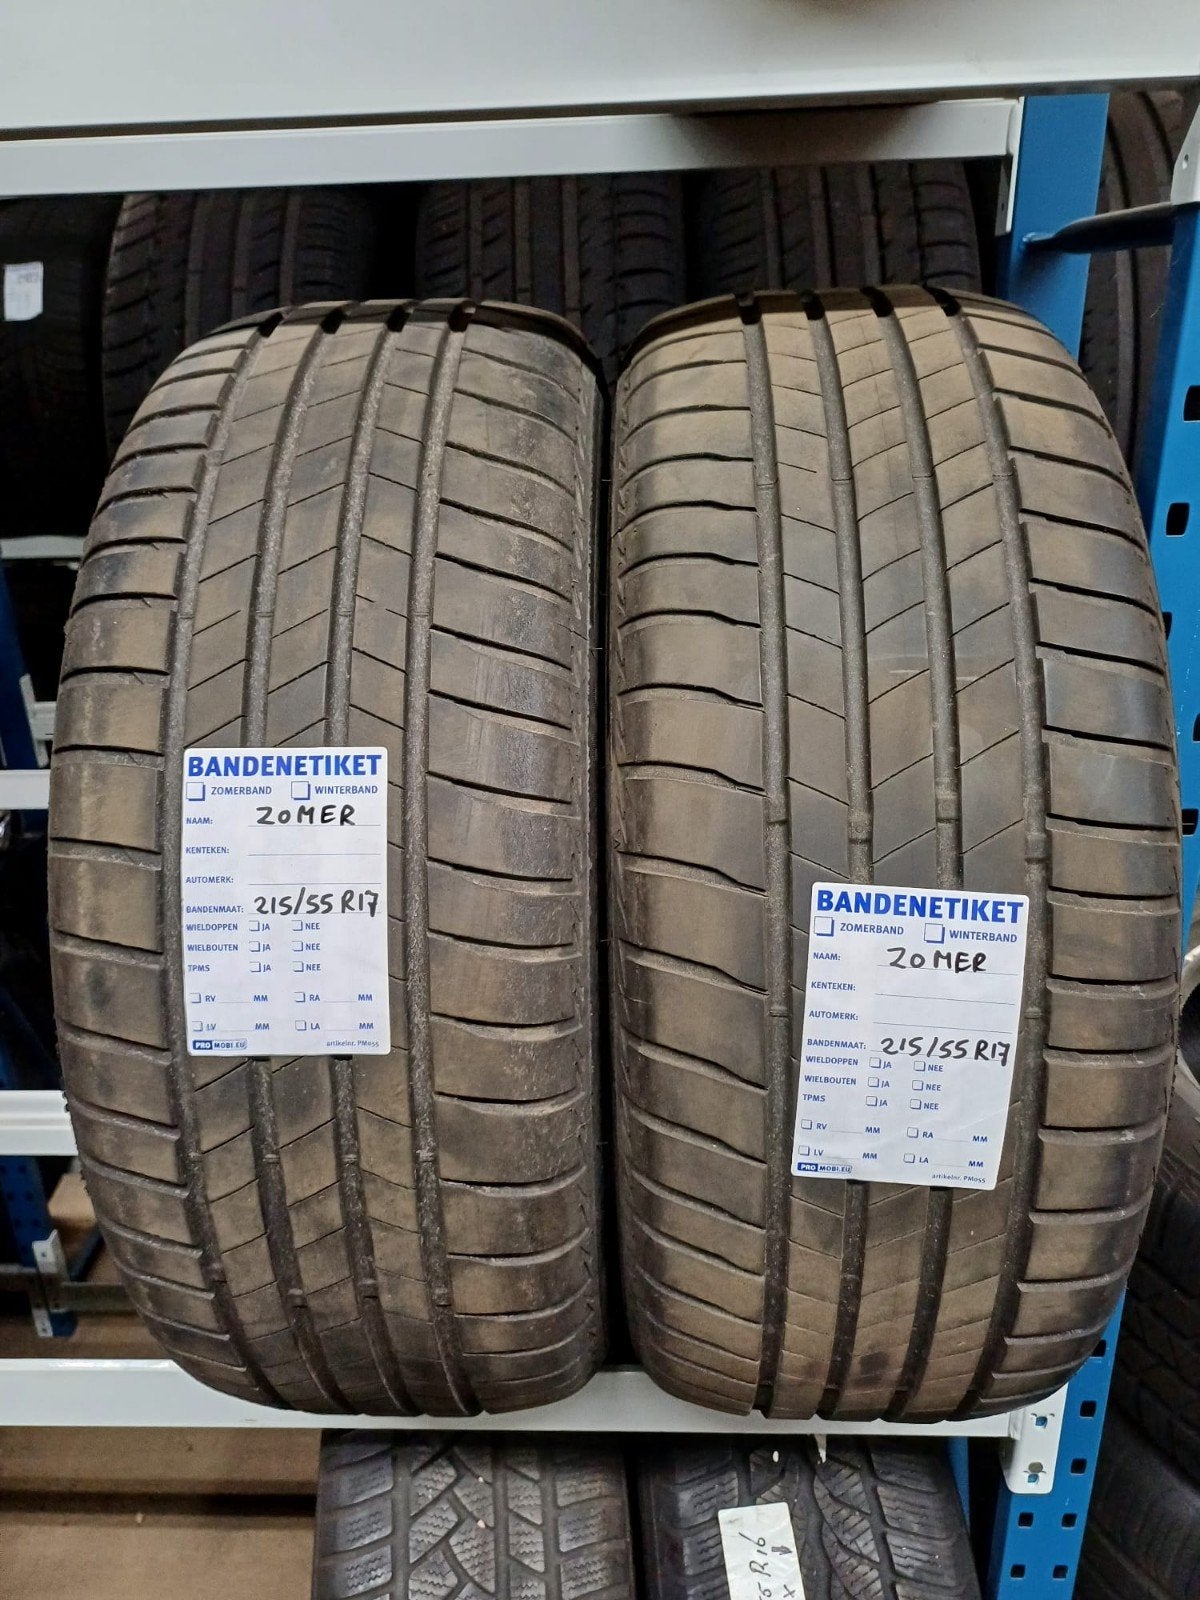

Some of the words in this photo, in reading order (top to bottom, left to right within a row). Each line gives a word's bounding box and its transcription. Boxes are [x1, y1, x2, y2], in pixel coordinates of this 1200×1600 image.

[188, 754, 382, 777] BANDENETIKET
[211, 786, 272, 795] ZOMERBAND
[315, 785, 378, 794] WINTERBAND
[256, 804, 355, 826] ZOMER
[186, 817, 213, 825] NAAM:
[254, 887, 334, 916] 215/55
[341, 890, 379, 917] R17
[186, 905, 244, 913] BANDENMAAT:
[817, 890, 1024, 924] BANDENETIKET
[262, 923, 270, 931] JA
[840, 923, 904, 935] ZOMERBAND
[949, 930, 1017, 943] WINTERBAND
[262, 944, 271, 952] JA
[813, 952, 841, 961] NAAM:
[887, 947, 986, 973] ZOMER
[263, 964, 271, 972] JA
[811, 981, 856, 991] KENTEKEN:
[809, 1011, 858, 1020] AUTOMERK:
[807, 1039, 866, 1050] BANDENMAAT:
[880, 1036, 969, 1059] 215/55
[974, 1039, 1010, 1066] R17
[806, 1055, 859, 1066] WIELDOPPEN
[883, 1061, 892, 1070] JA
[928, 1064, 943, 1072] NEE
[804, 1075, 856, 1085] WIELBOUTEN
[881, 1080, 890, 1088] JA
[802, 1094, 826, 1102] TPMS
[879, 1099, 888, 1107] JA
[865, 1126, 880, 1134] MM
[923, 1131, 933, 1139] RA
[972, 1135, 988, 1143] MM
[968, 1160, 984, 1168] MM
